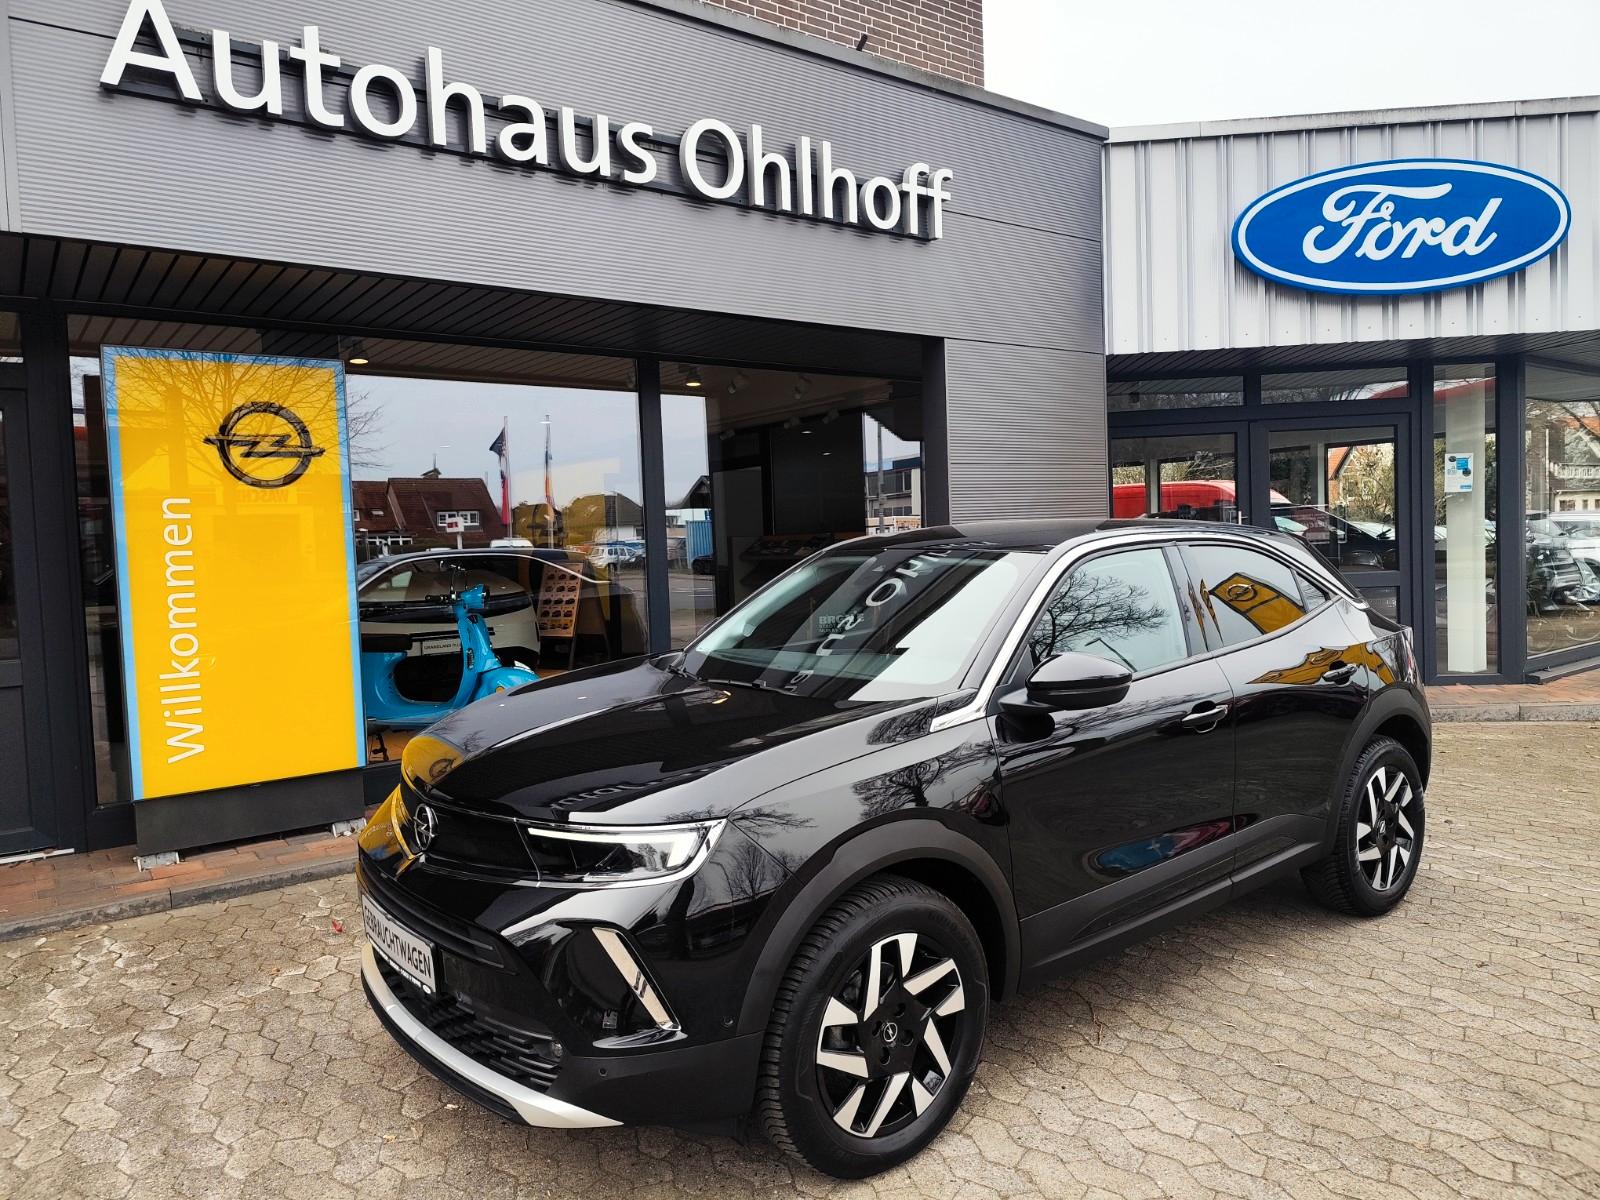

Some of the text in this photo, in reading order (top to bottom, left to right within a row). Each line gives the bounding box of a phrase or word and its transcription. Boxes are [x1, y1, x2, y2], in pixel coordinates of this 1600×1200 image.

[99, 0, 954, 241] Autohaus Ohlhoff
[1302, 182, 1503, 264] Ford
[158, 496, 205, 764] Willkommen
[364, 905, 432, 978] GEBRAUCHTWAGEN
